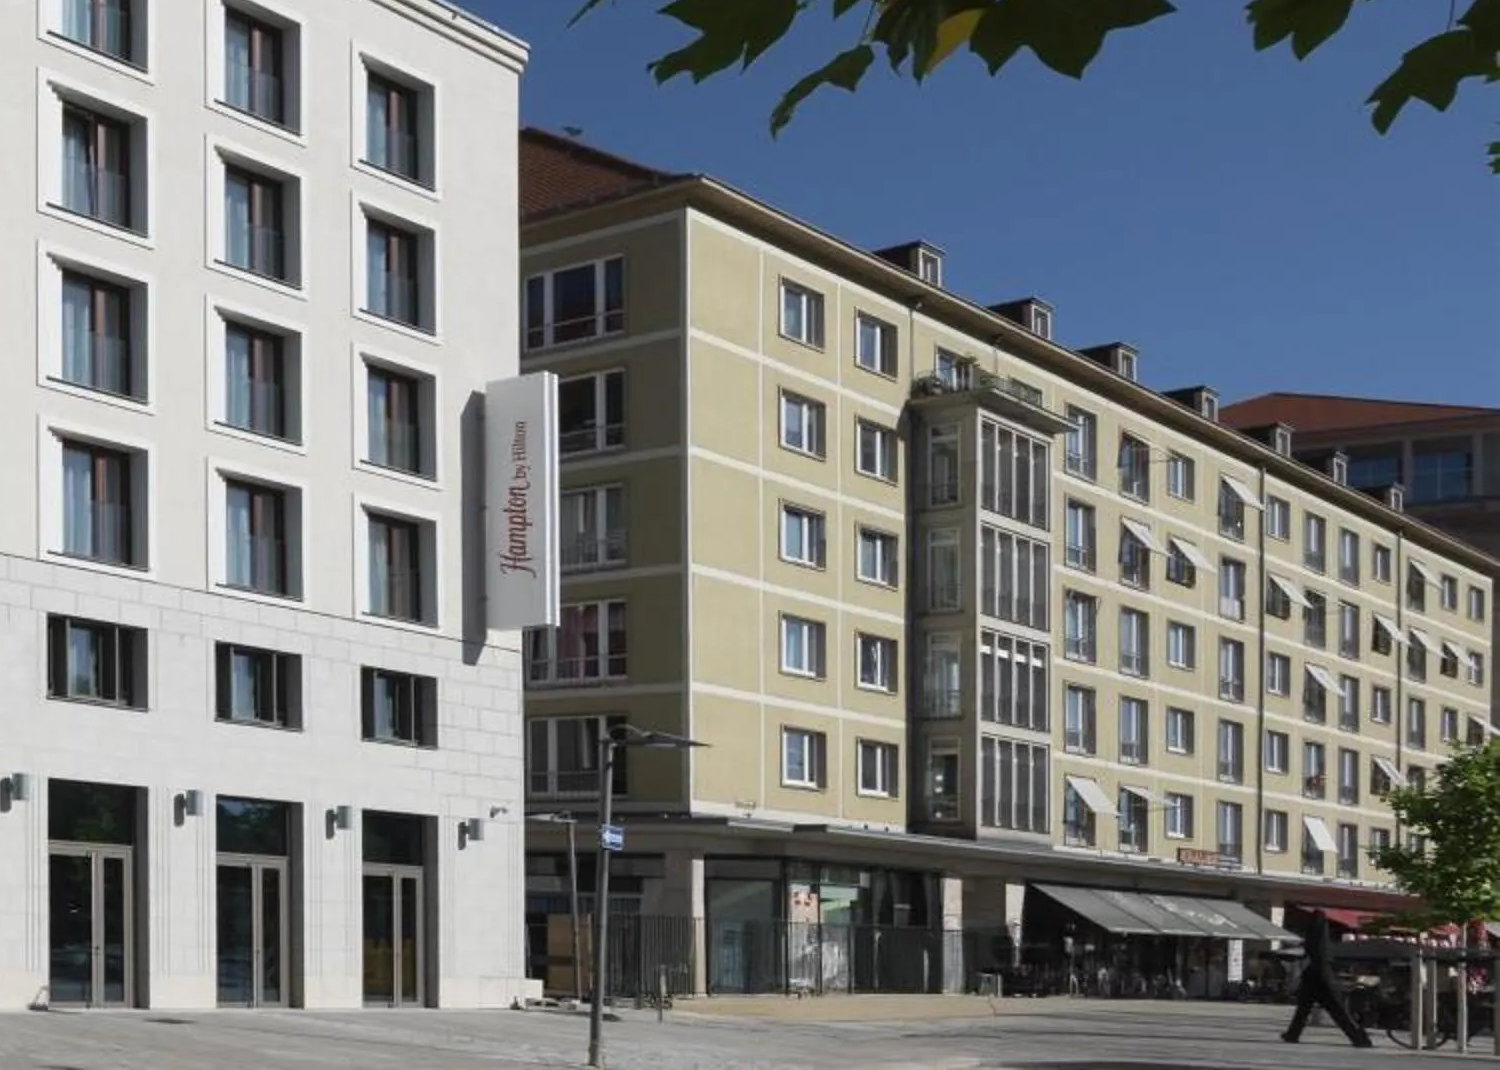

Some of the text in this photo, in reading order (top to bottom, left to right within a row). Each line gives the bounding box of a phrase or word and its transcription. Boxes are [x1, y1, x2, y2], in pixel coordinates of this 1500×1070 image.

[500, 421, 536, 578] Hampton by Hilton
